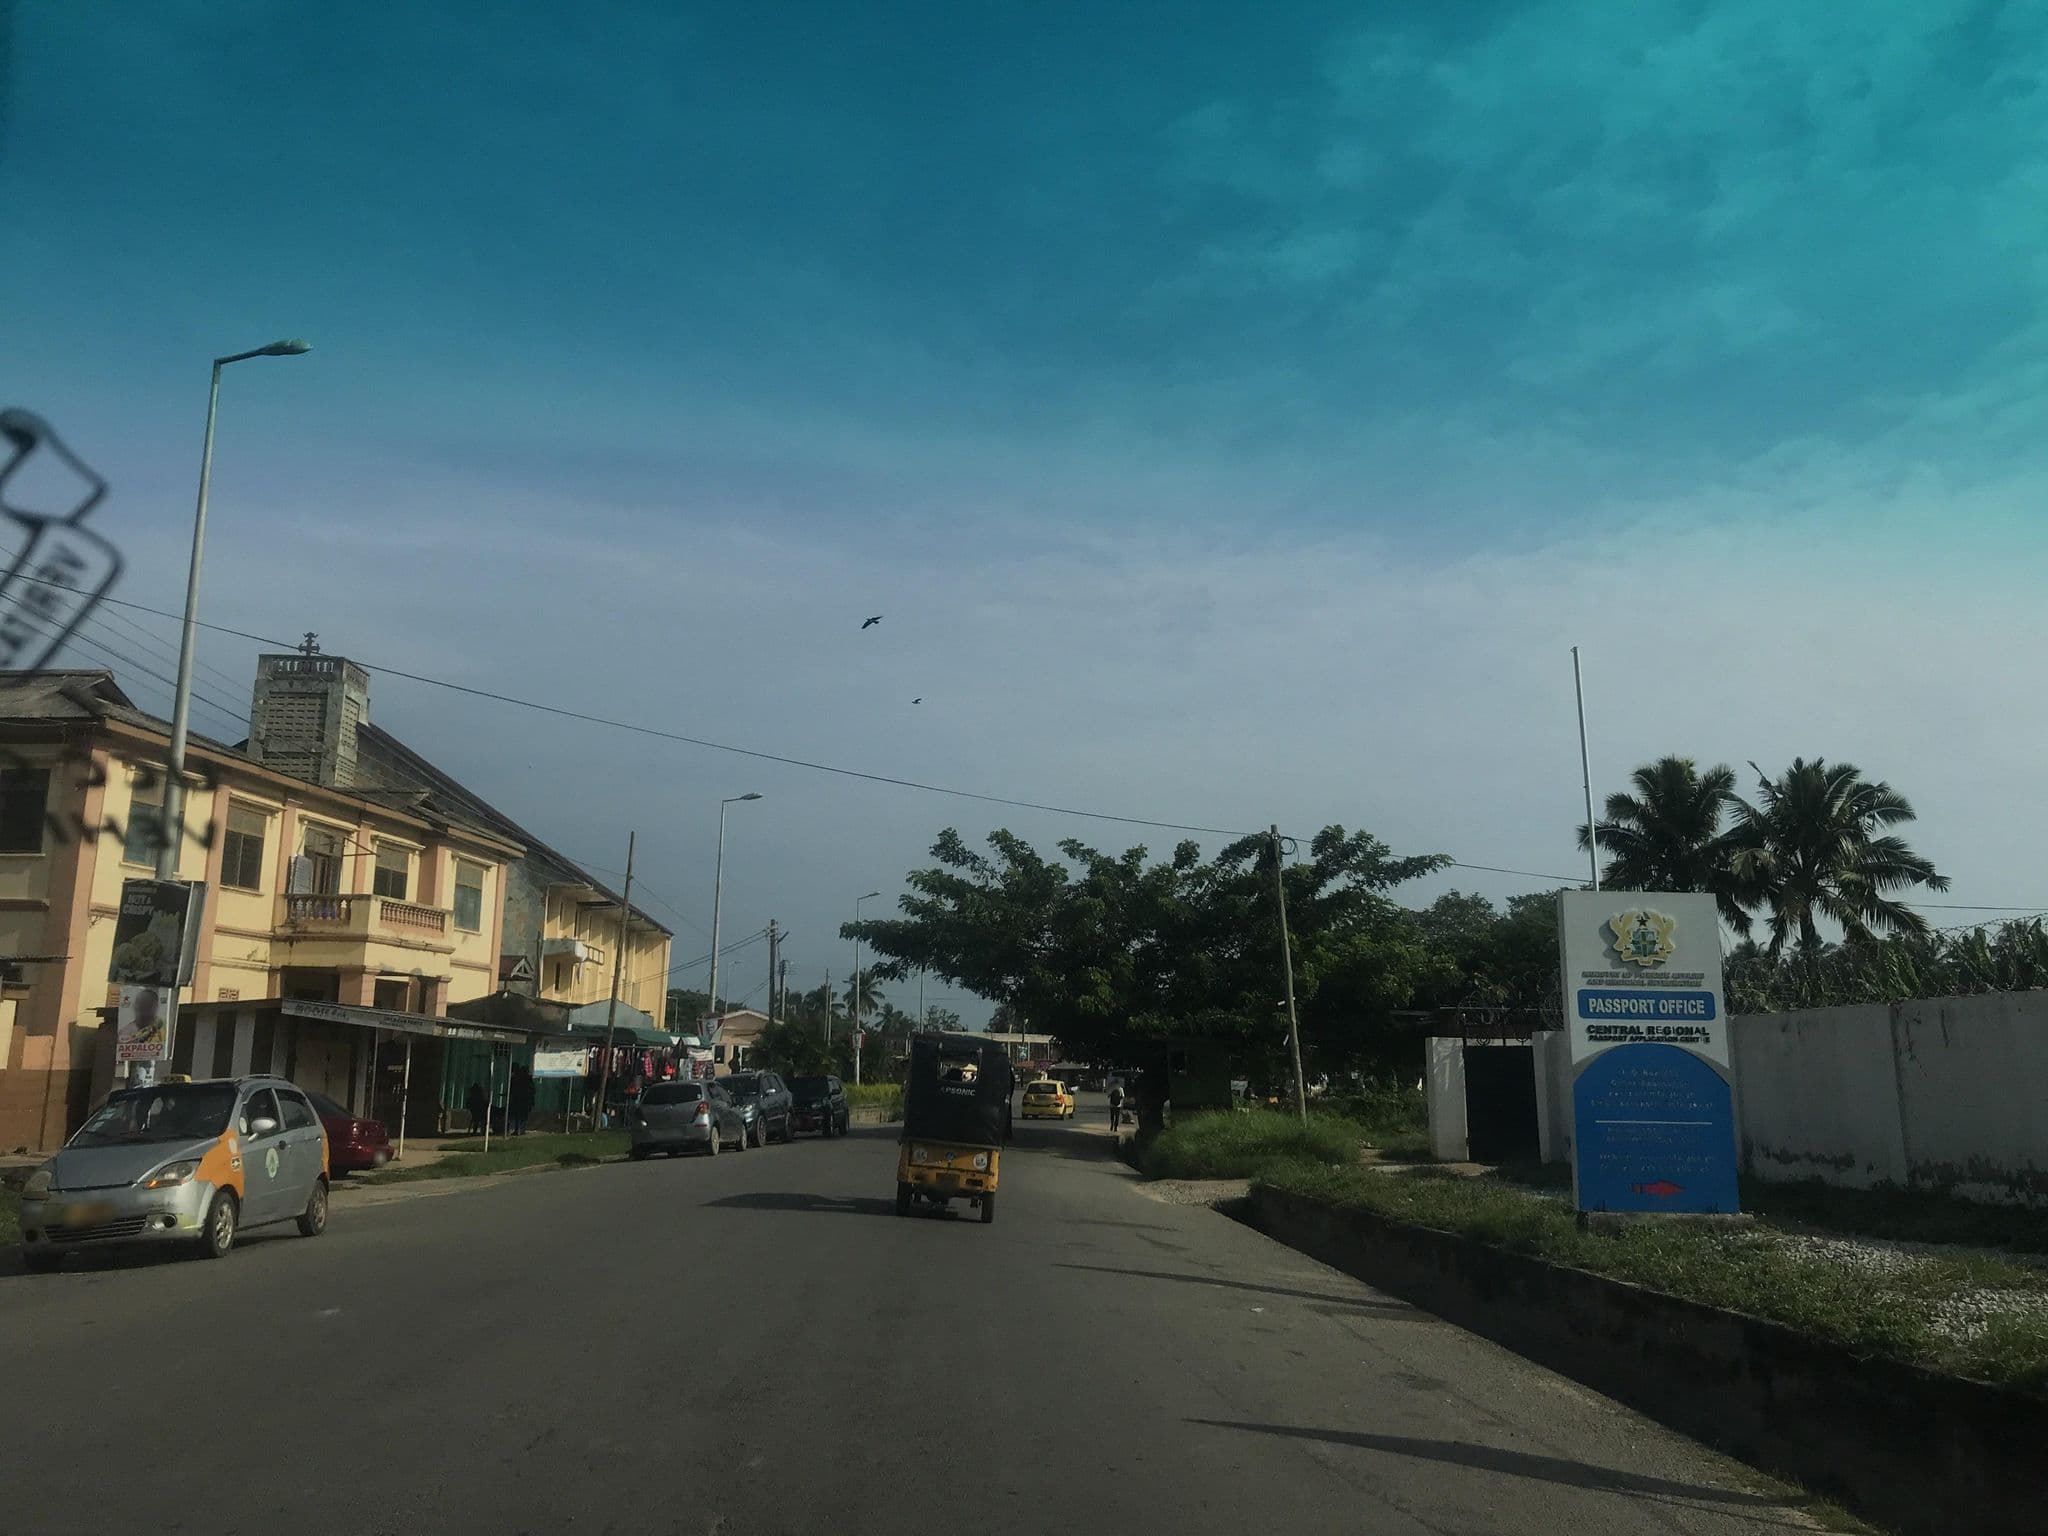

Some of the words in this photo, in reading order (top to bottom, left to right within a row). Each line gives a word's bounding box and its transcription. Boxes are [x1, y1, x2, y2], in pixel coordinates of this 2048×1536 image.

[1588, 998, 1655, 1014] PASSPORT
[1659, 1000, 1705, 1015] OFFICE
[1586, 1024, 1643, 1035] CENTRAL
[1647, 1025, 1709, 1036] REGIONAL
